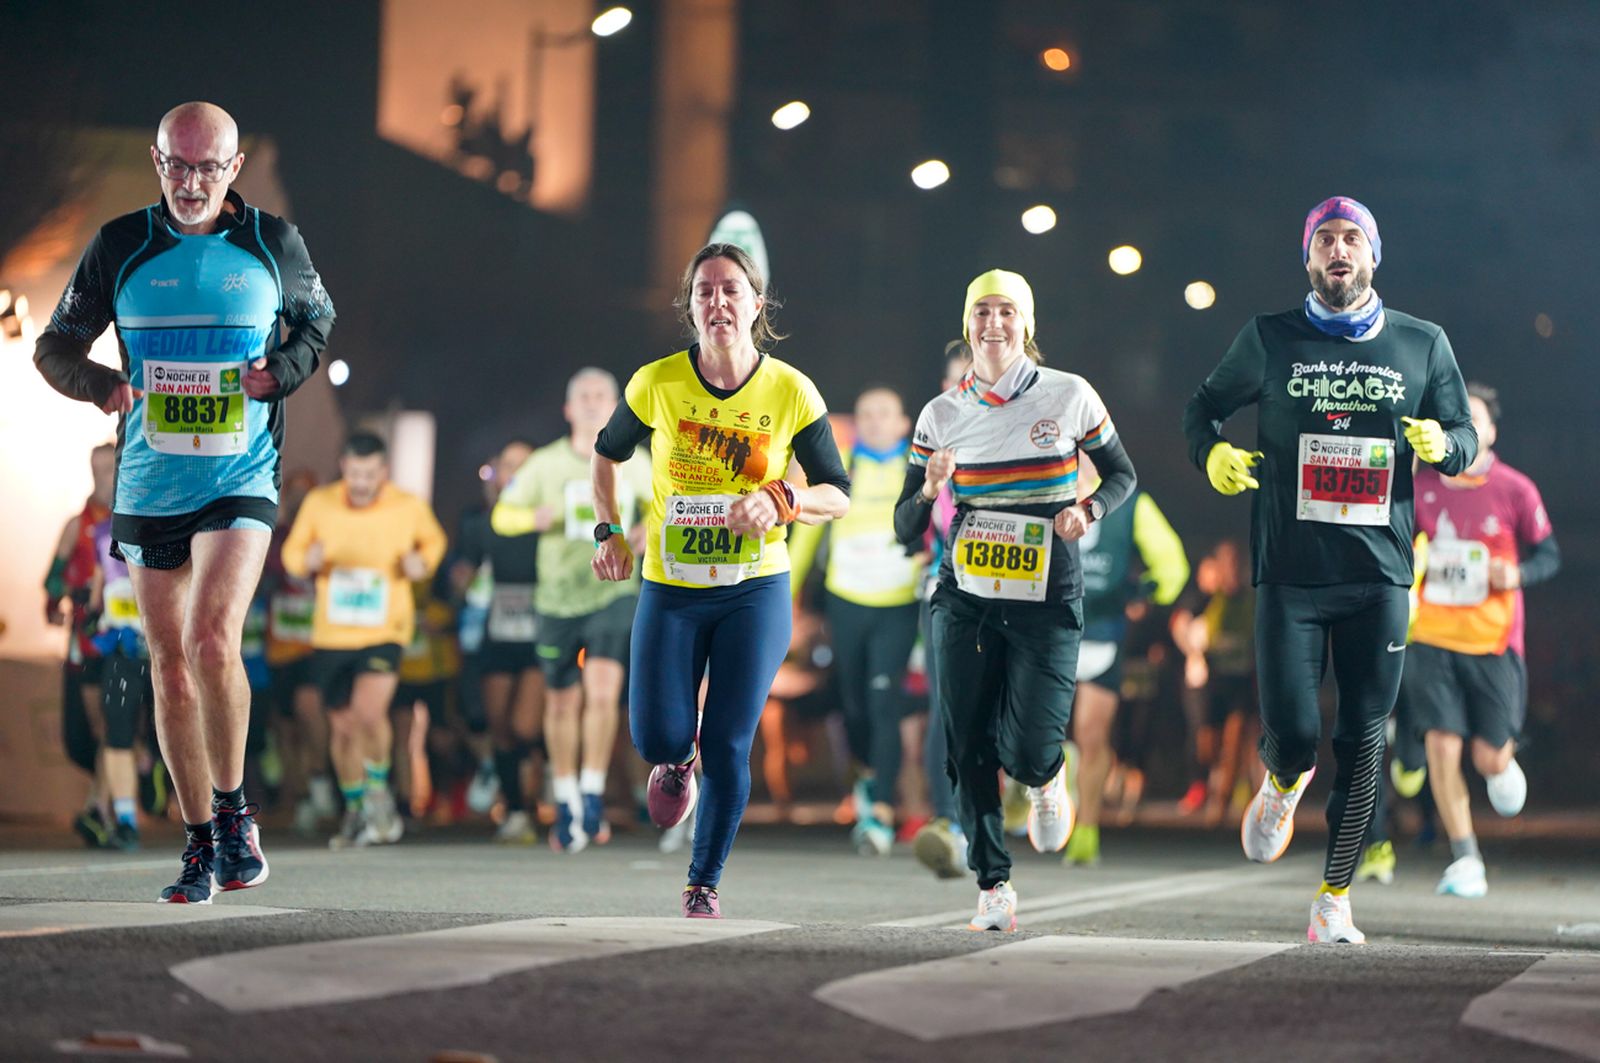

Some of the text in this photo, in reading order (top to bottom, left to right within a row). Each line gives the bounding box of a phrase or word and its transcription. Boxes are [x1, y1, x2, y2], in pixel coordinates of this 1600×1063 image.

[131, 329, 198, 356] MEDIA
[166, 372, 211, 382] NOCHE DE
[1292, 361, 1403, 381] Bank of America
[155, 383, 175, 394] SAN
[176, 382, 212, 395] ANTÓN
[164, 395, 230, 424] 8837
[1311, 398, 1378, 413] Marathon
[1332, 416, 1352, 430] 24
[1321, 445, 1362, 456] NOCHE DE
[1310, 454, 1329, 465] SAN
[669, 461, 720, 476] NOCHE DE
[669, 469, 687, 479] SAN
[1312, 466, 1380, 495] 13755
[713, 505, 724, 514] DE
[674, 517, 692, 525] SAN
[976, 520, 1004, 532] NOCHE
[1005, 523, 1017, 532] DE
[682, 527, 744, 554] 2847
[965, 529, 984, 539] SAN
[964, 541, 1039, 572] 13889
